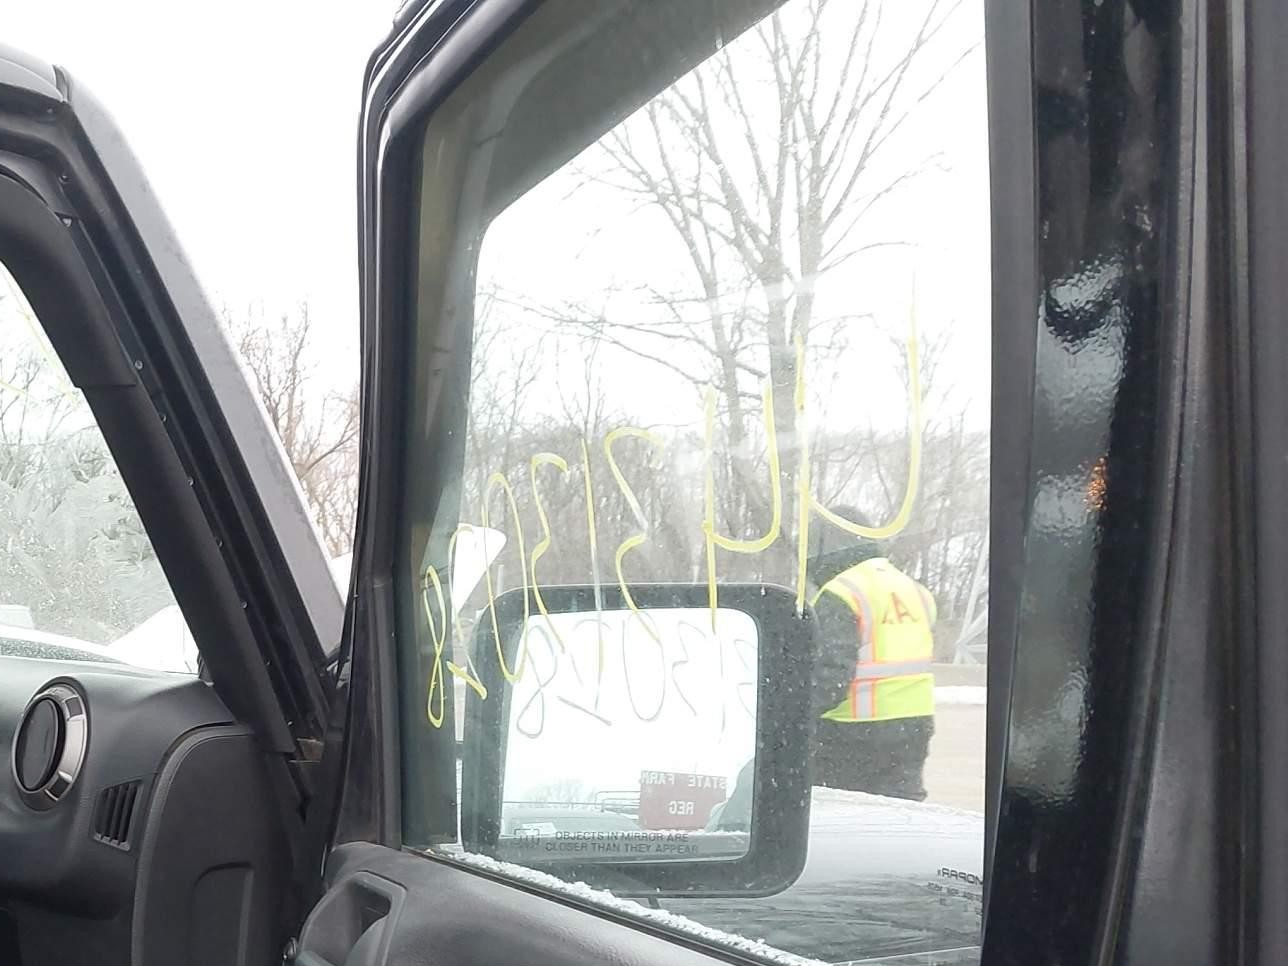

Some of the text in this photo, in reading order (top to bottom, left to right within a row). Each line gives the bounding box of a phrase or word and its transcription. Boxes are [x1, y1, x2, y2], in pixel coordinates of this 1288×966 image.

[555, 831, 689, 843] OBJECTS IN MIRROR ARE
[545, 842, 588, 852] CLOSER
[591, 842, 621, 852] THAN
[624, 843, 652, 853] THEY
[655, 844, 698, 855] APPEAR
